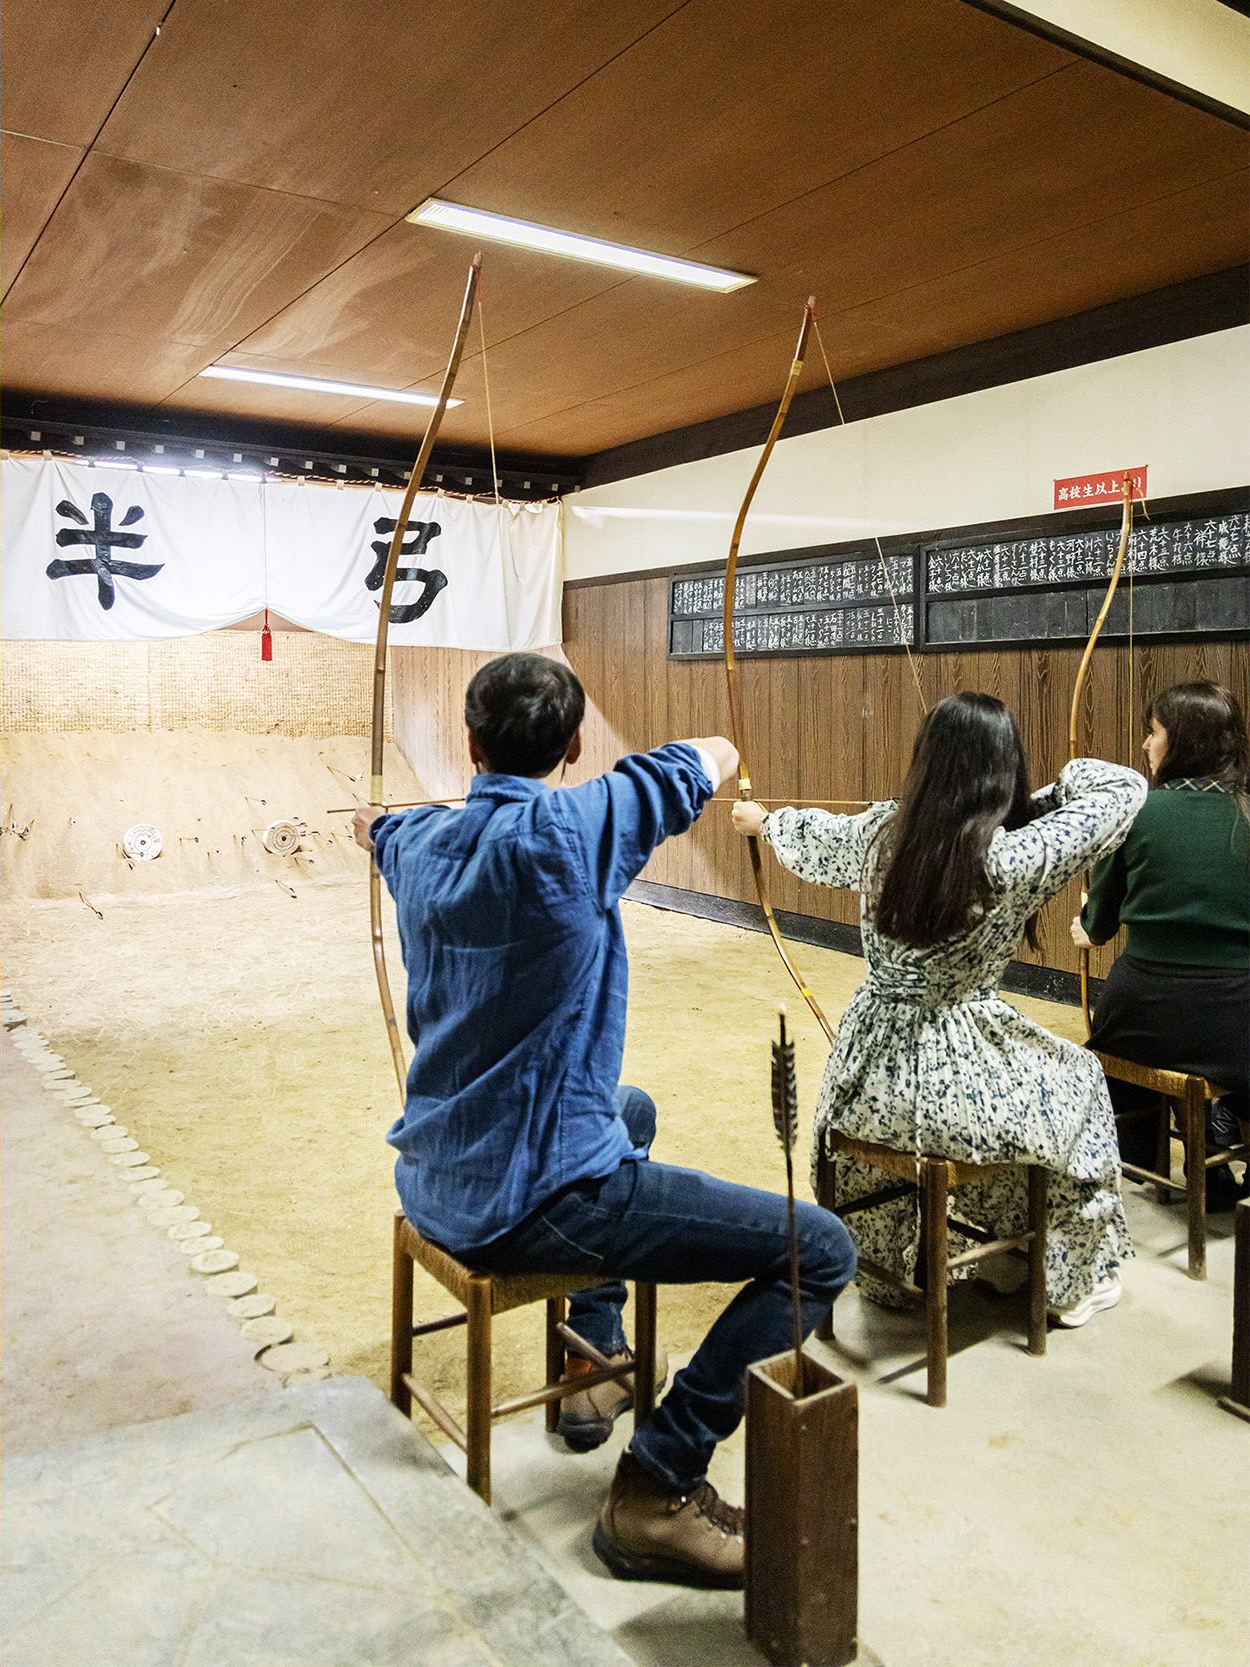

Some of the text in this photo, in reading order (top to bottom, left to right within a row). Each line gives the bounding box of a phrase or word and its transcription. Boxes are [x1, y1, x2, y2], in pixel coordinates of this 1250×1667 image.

[935, 555, 944, 587] 六十点
[951, 551, 960, 586] 六十点
